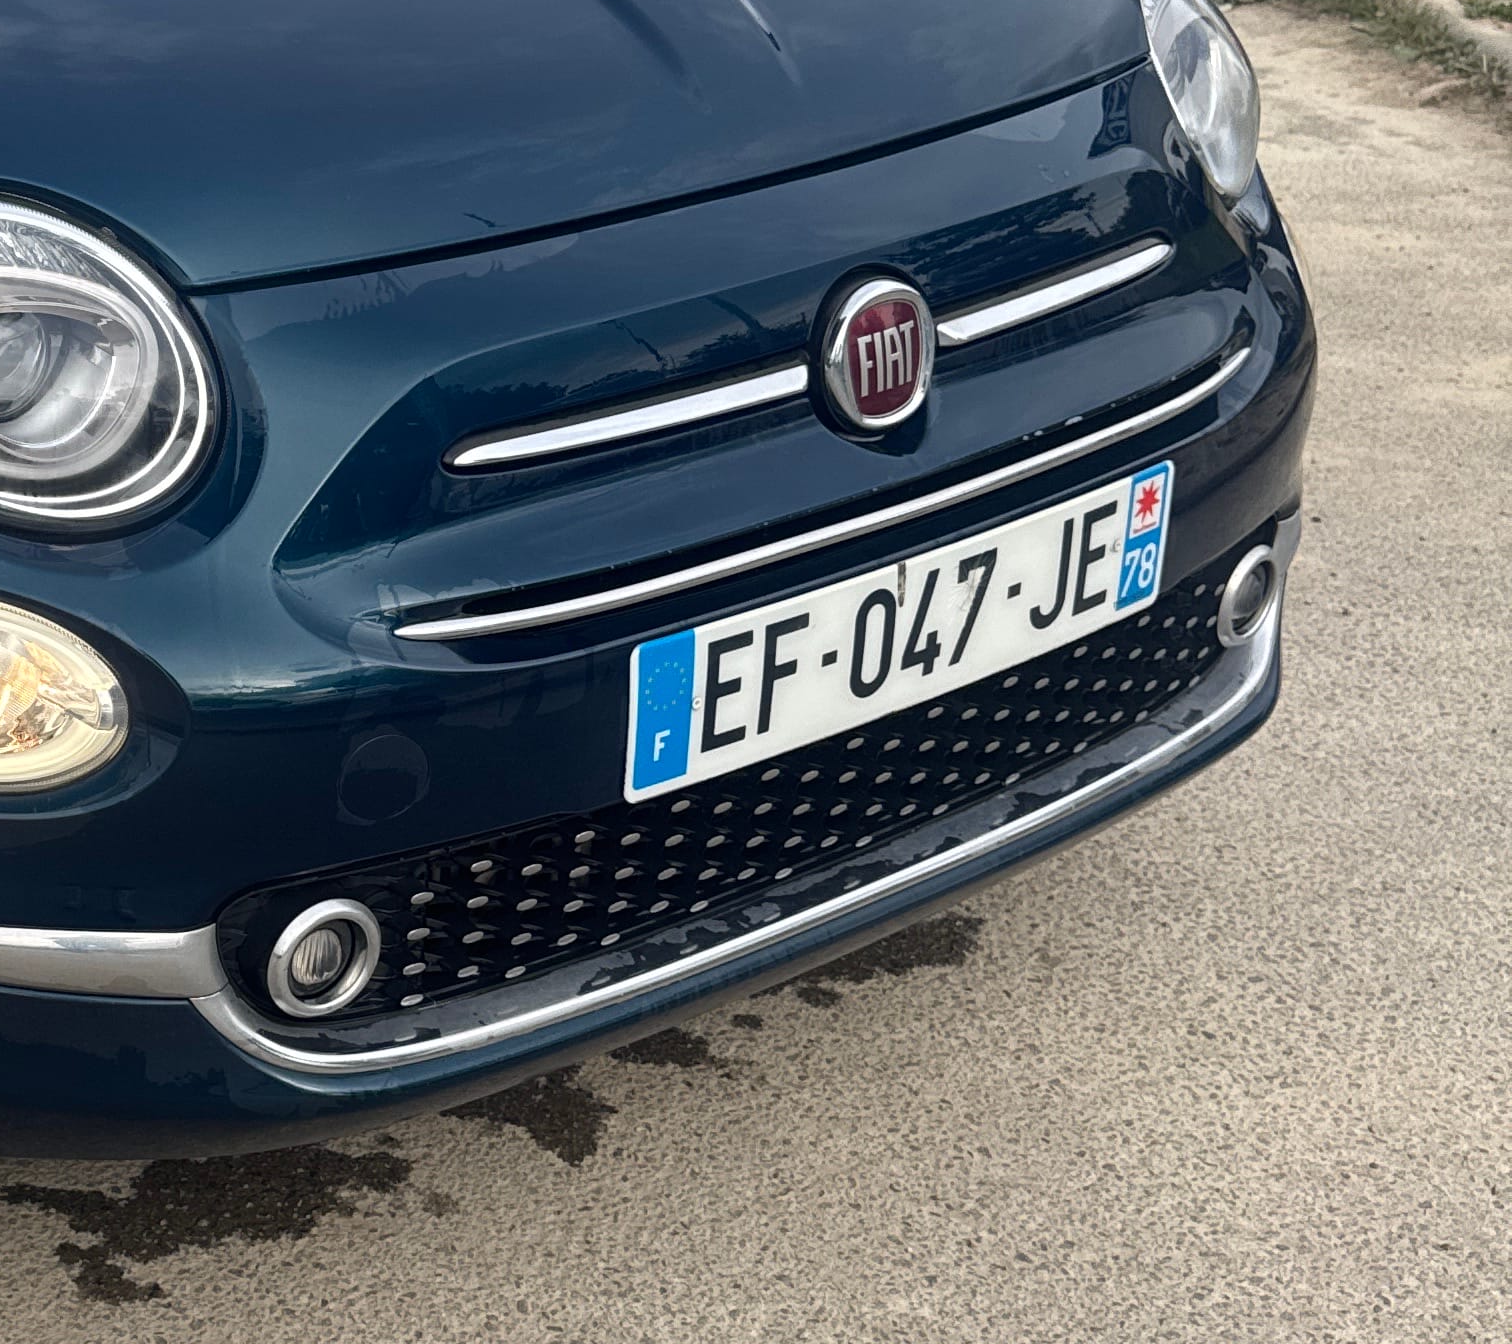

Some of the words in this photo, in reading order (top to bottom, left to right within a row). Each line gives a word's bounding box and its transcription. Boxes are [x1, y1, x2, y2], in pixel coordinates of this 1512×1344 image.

[857, 319, 914, 398] FIAT
[1121, 542, 1157, 599] 78
[700, 500, 1119, 754] EF-047-JE
[653, 729, 671, 762] F
